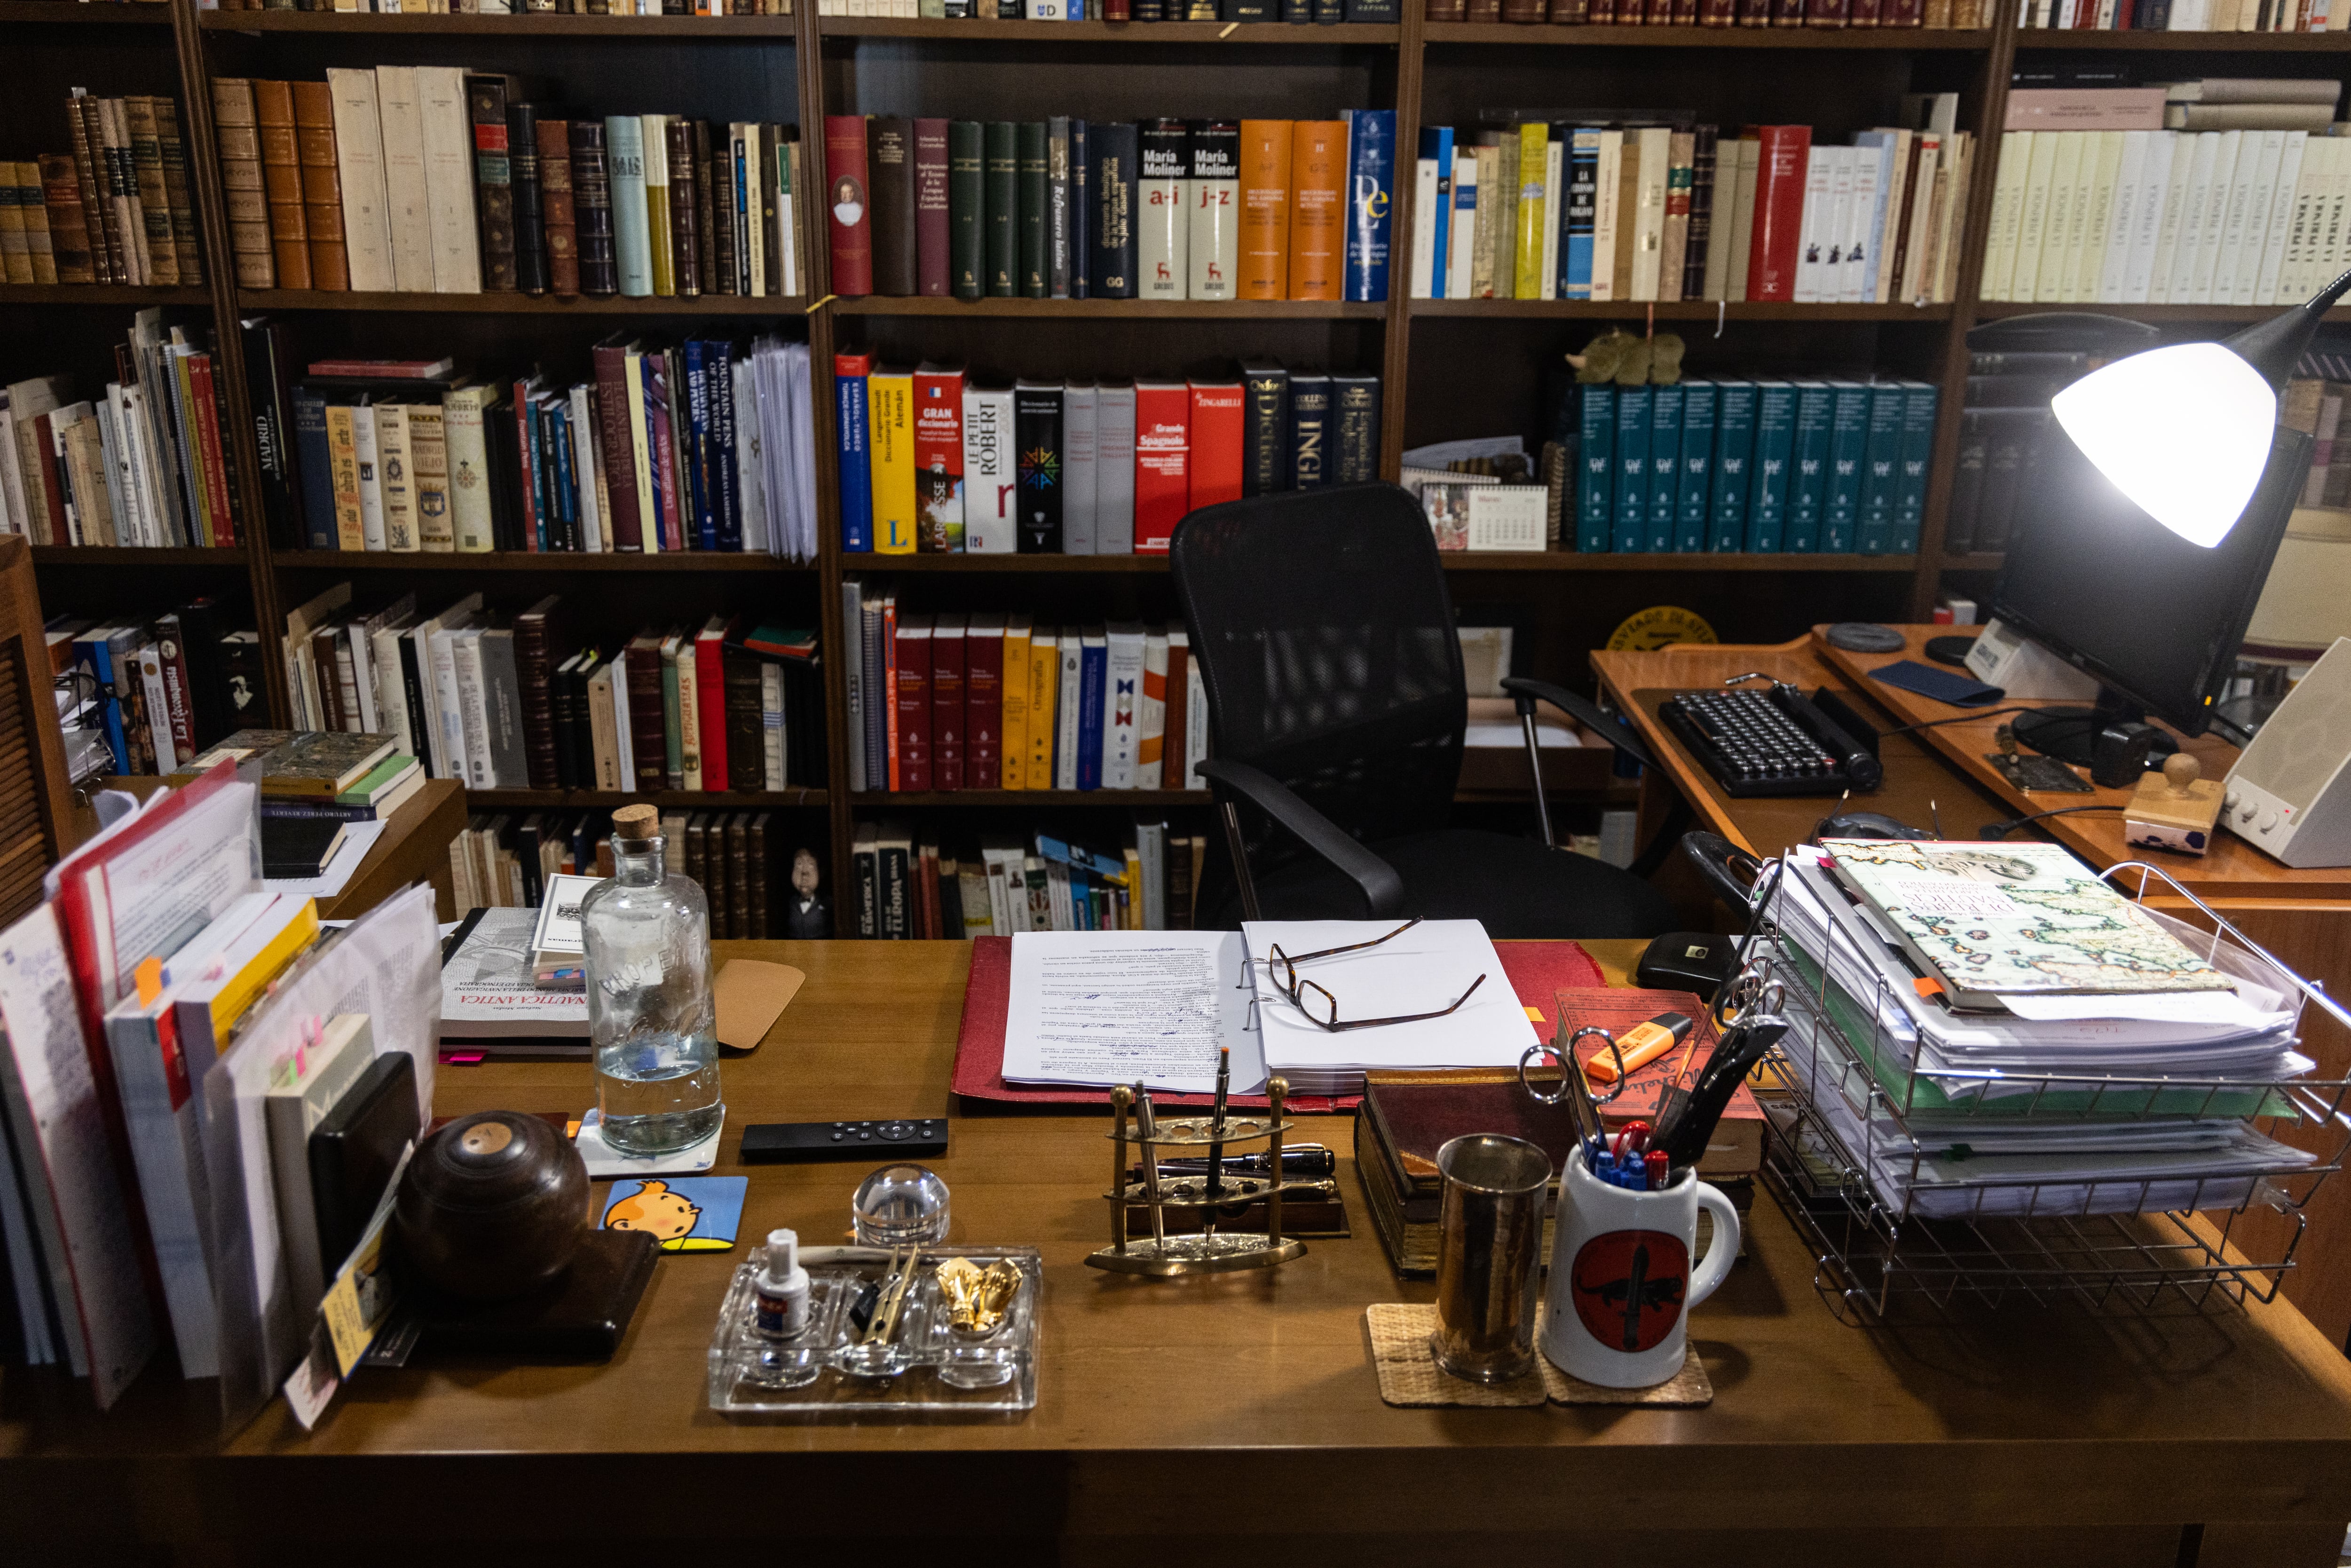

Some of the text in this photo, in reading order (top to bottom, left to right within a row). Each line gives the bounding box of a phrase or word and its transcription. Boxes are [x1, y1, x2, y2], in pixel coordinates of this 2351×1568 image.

[1144, 149, 1177, 163] María
[1195, 149, 1228, 163] María
[1144, 164, 1186, 176] Moliner
[1195, 164, 1237, 176] Moliner
[1150, 186, 1178, 205] a-i
[1200, 186, 1230, 207] j-z
[2288, 248, 2299, 263] LA
[2304, 248, 2315, 263] LA
[2323, 248, 2334, 263] LA
[1250, 378, 1287, 393] Oxford
[709, 362, 722, 442] OF THE WORLD
[718, 356, 733, 448] FOUNTAIN PENS
[894, 389, 904, 428] Alemán
[1199, 398, 1241, 408] ZINGARELLI
[923, 408, 953, 418] GRAN
[917, 418, 959, 429] diccionario
[1155, 423, 1185, 433] Grande
[255, 415, 273, 470] MADRID
[967, 413, 980, 465] LE PETIT
[979, 402, 996, 475] ROBERT
[1140, 434, 1185, 447] Spagnolo
[1989, 904, 2016, 912] DE
[459, 995, 587, 1005] NAUTICA ANTICA
